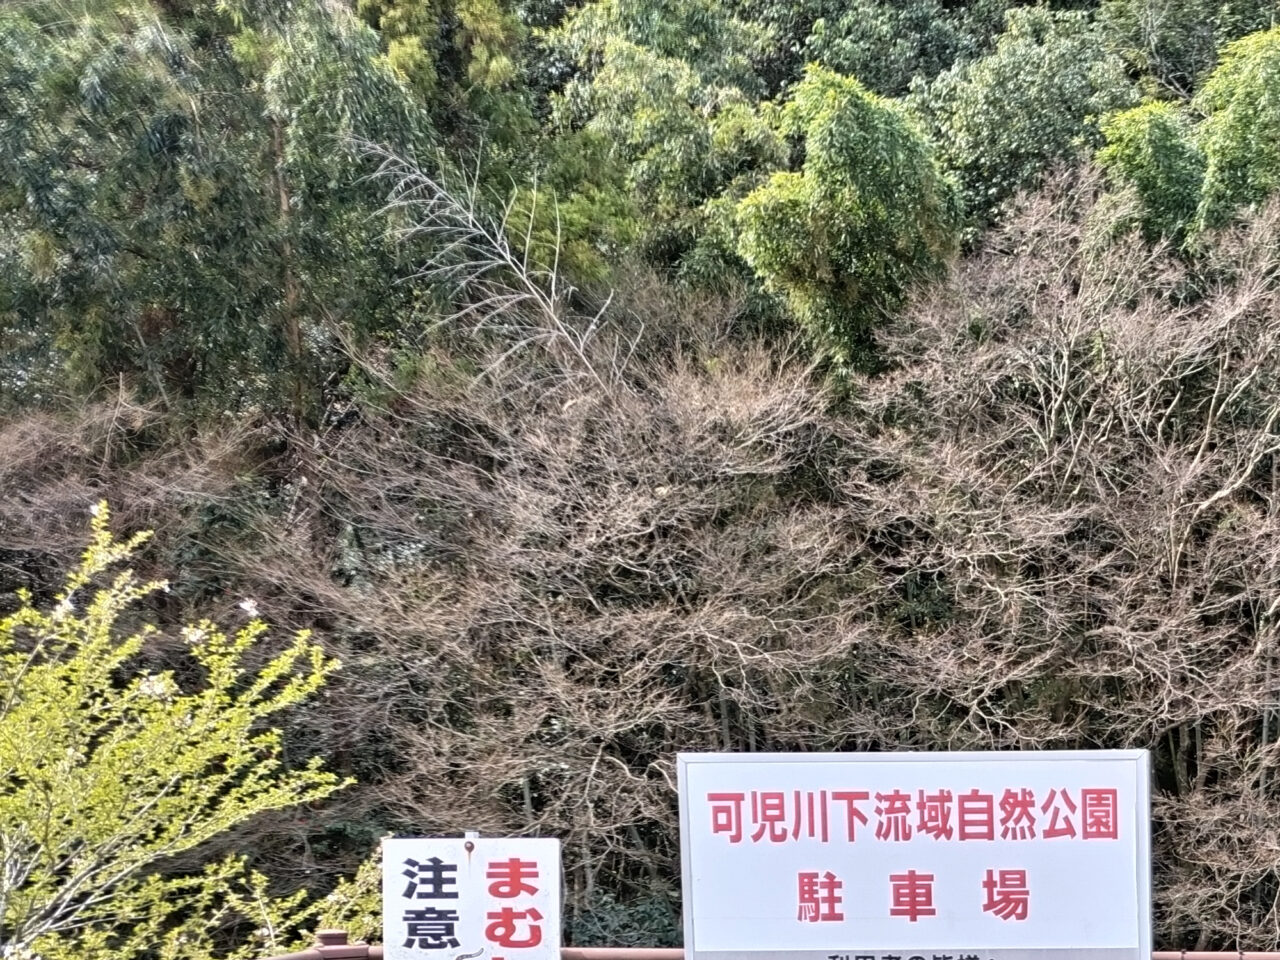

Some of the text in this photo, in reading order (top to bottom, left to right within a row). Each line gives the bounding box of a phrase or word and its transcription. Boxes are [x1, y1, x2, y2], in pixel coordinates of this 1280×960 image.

[707, 788, 1118, 843] 可児川下流域自然公園
[401, 856, 461, 949] 注意
[796, 869, 1031, 922] 駐車場
